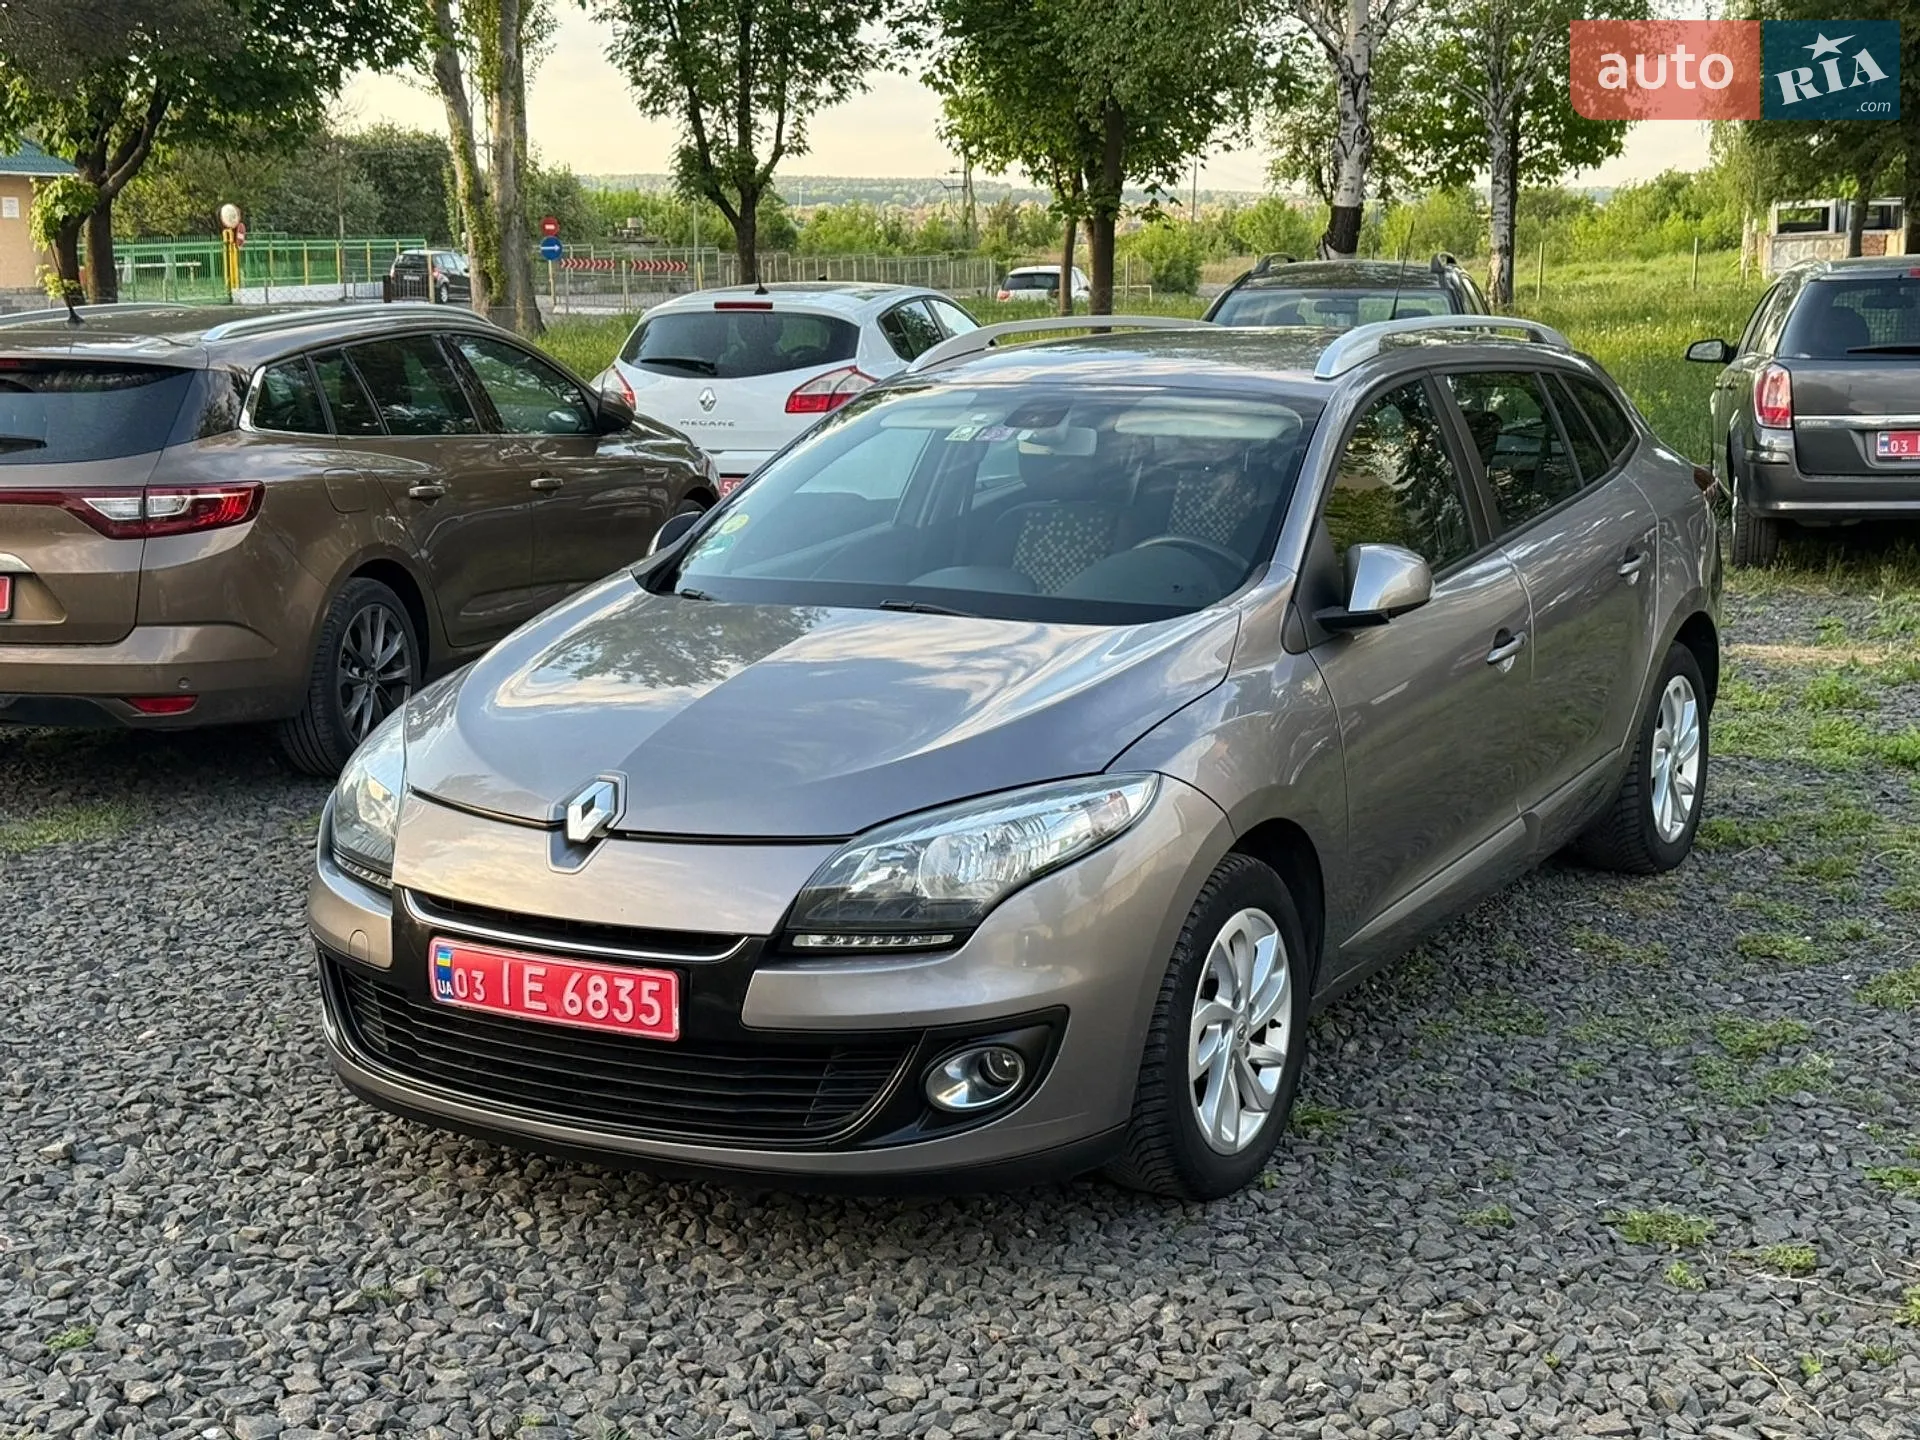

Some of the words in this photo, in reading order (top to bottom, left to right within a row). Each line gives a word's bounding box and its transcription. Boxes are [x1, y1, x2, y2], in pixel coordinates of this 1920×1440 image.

[1890, 440, 1908, 452] 03
[437, 979, 454, 995] UA
[453, 967, 486, 1001] 03
[562, 972, 662, 1026] 6835
